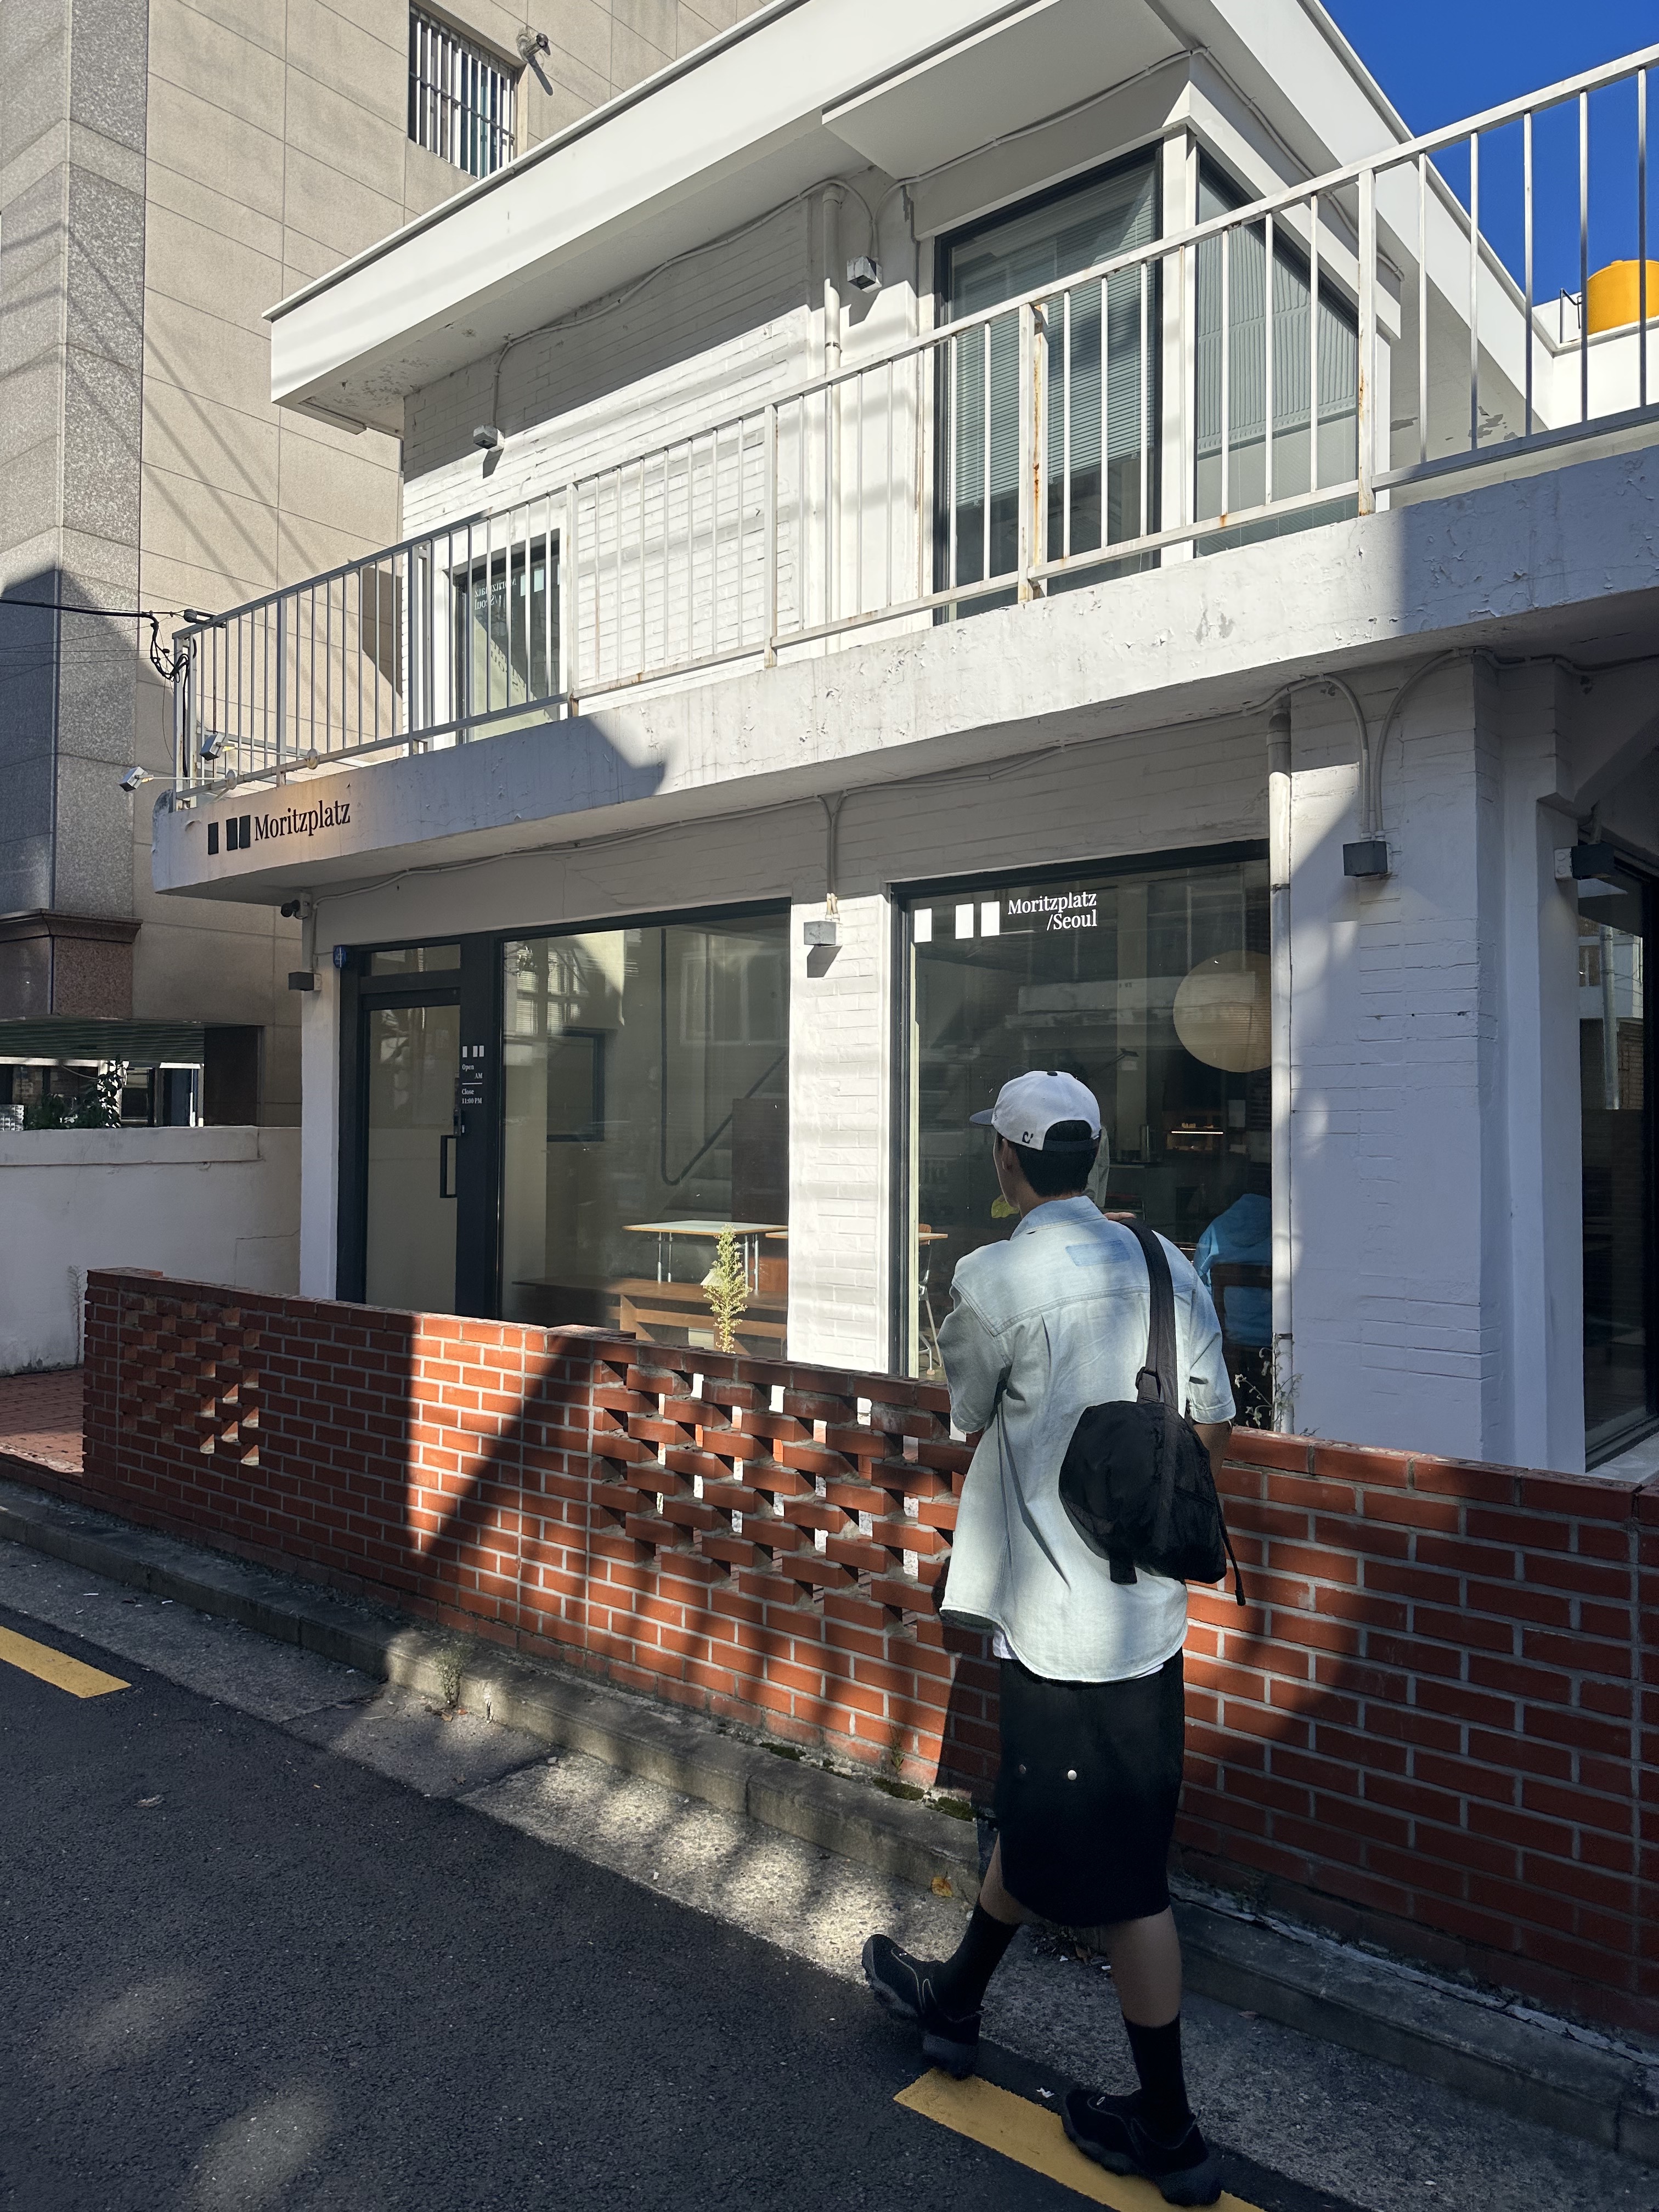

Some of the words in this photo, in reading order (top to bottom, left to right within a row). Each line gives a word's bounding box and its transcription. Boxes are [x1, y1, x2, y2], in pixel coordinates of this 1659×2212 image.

[255, 800, 351, 840] Moritzplatz
[1007, 891, 1097, 915] Moritzplatz
[1046, 909, 1098, 931] /Seoul
